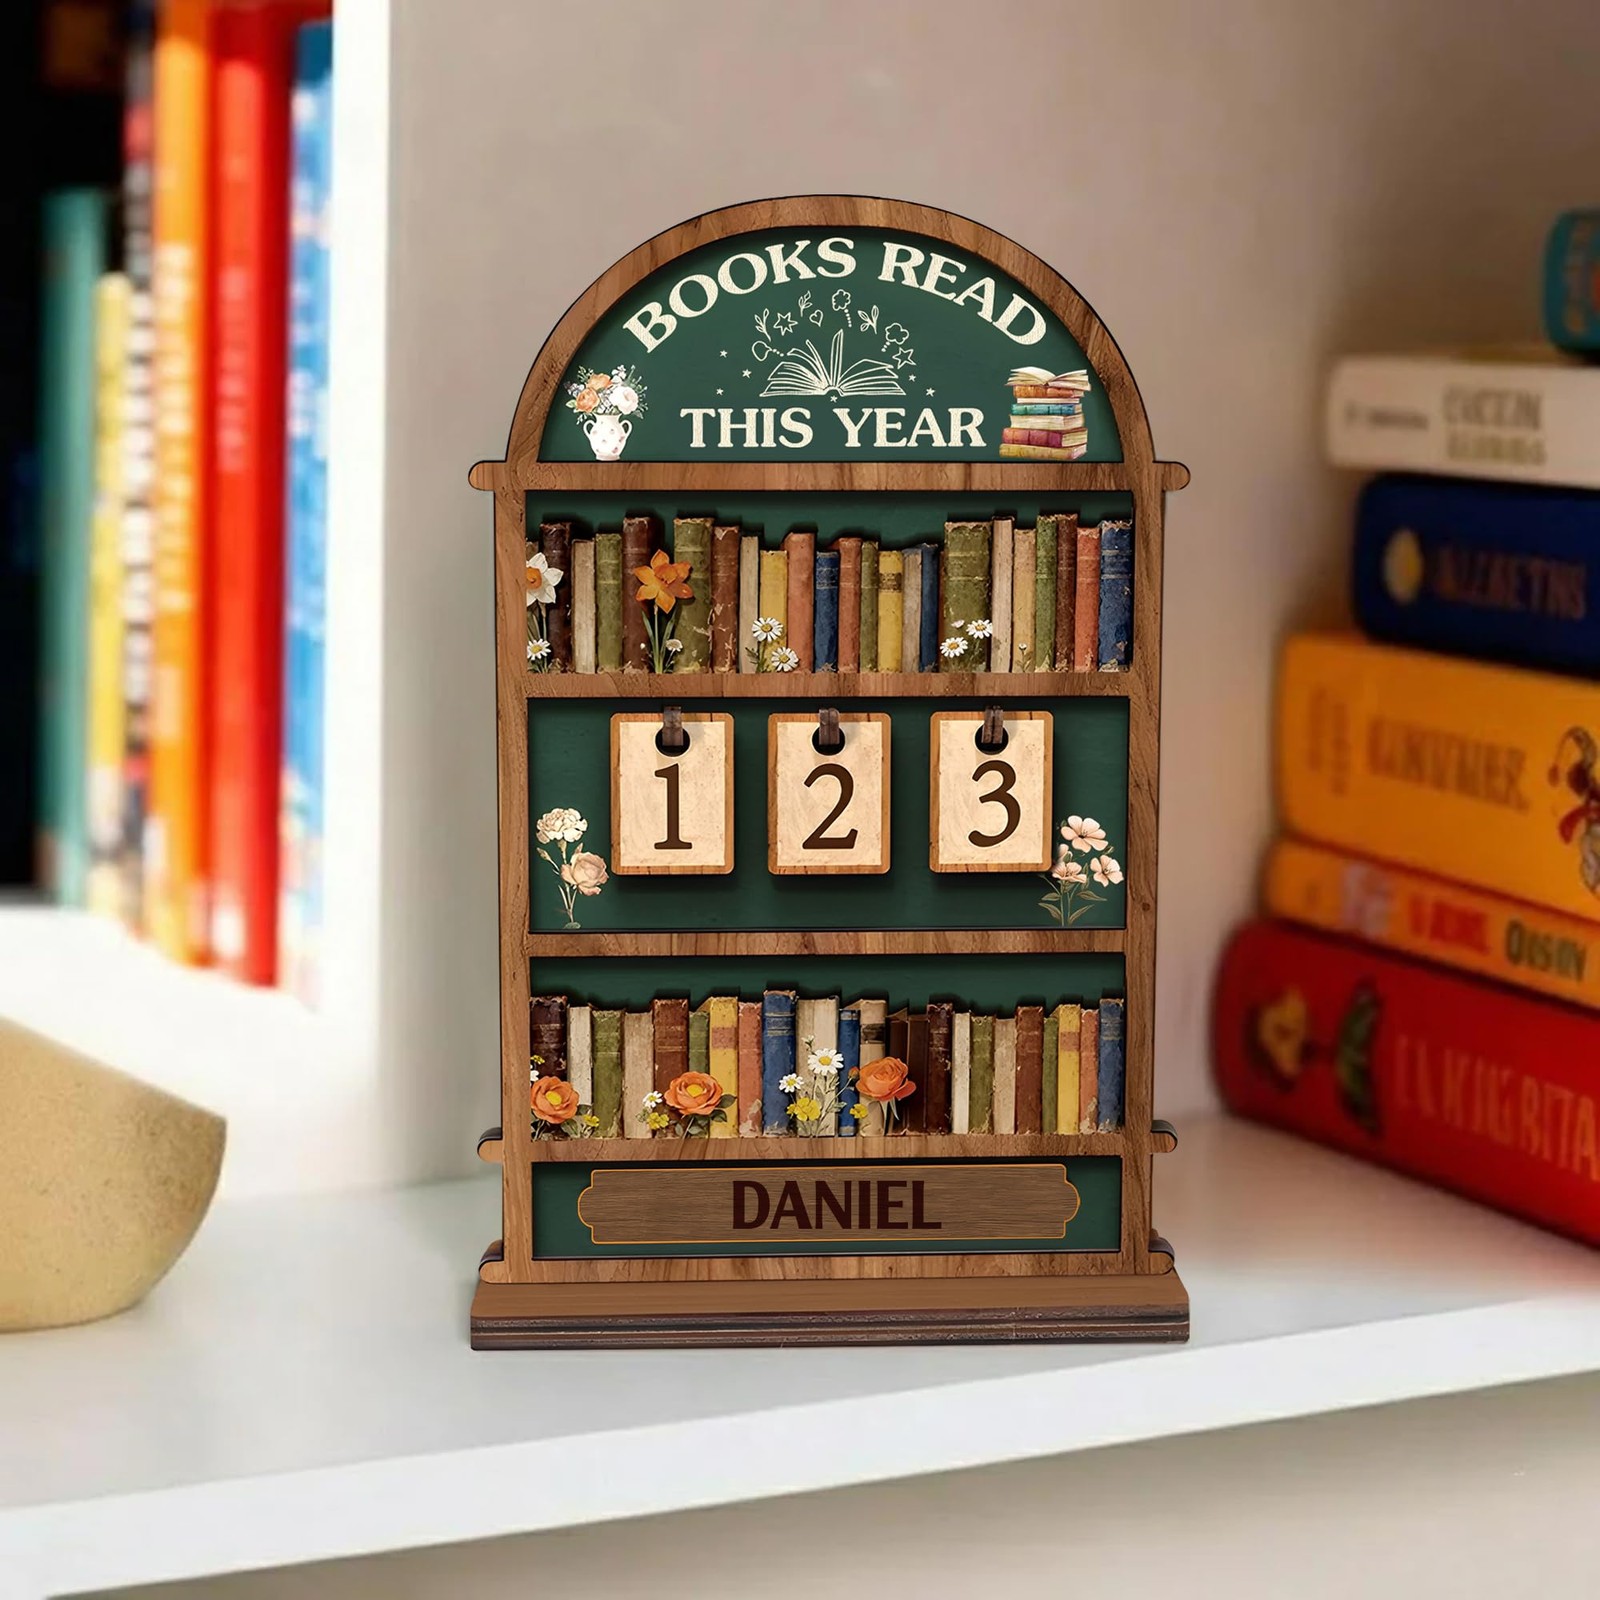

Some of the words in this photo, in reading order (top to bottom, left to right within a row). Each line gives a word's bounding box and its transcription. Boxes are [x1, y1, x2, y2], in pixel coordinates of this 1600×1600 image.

[622, 237, 857, 354] BOOKS
[877, 241, 1048, 347] READ
[680, 407, 814, 449] THIS
[833, 407, 987, 449] YEAR
[653, 762, 694, 851] 1
[802, 762, 859, 851] 2
[967, 759, 1021, 848] 3
[732, 1179, 943, 1231] DANIEL
